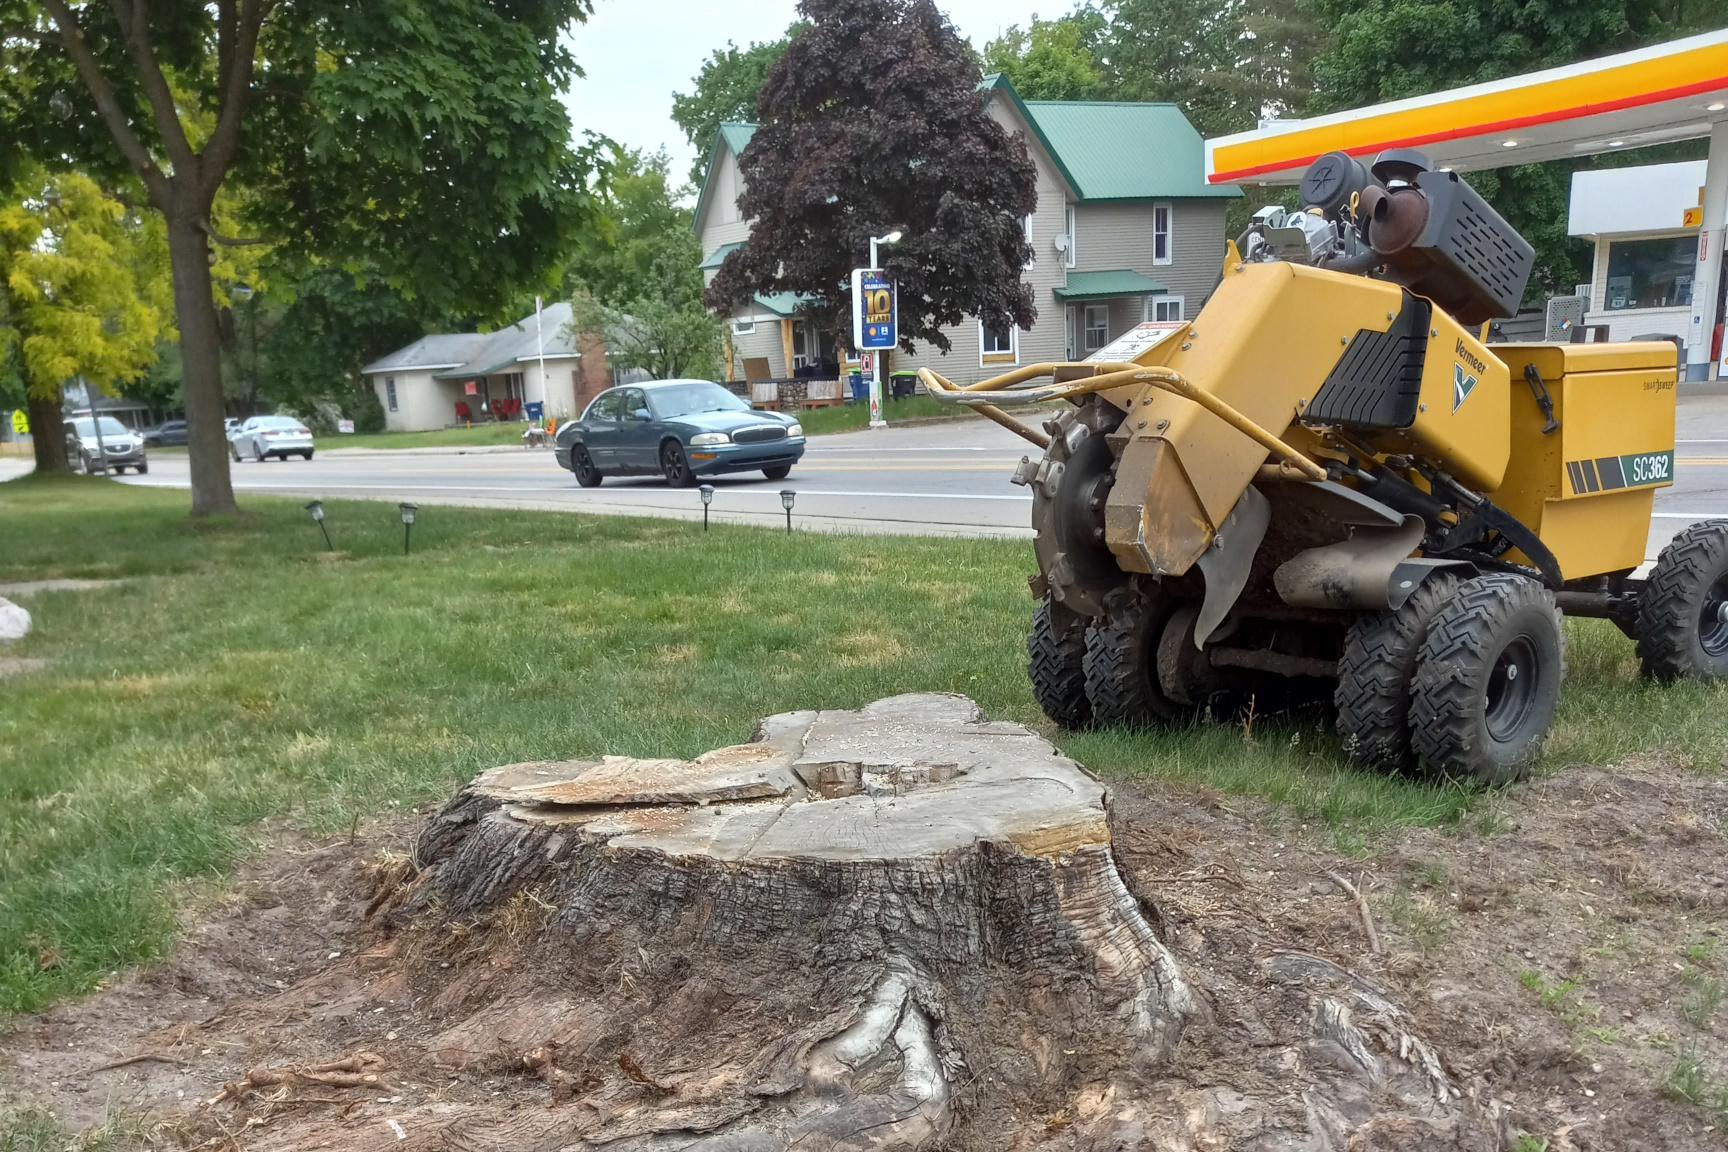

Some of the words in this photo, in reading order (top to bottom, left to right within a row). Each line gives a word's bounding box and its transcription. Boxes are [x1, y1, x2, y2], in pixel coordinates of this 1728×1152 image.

[1685, 212, 1693, 224] 2
[864, 289, 890, 314] 10
[868, 314, 889, 322] YEARS
[1455, 337, 1487, 376] Vermeer
[1633, 455, 1669, 482] SC362
